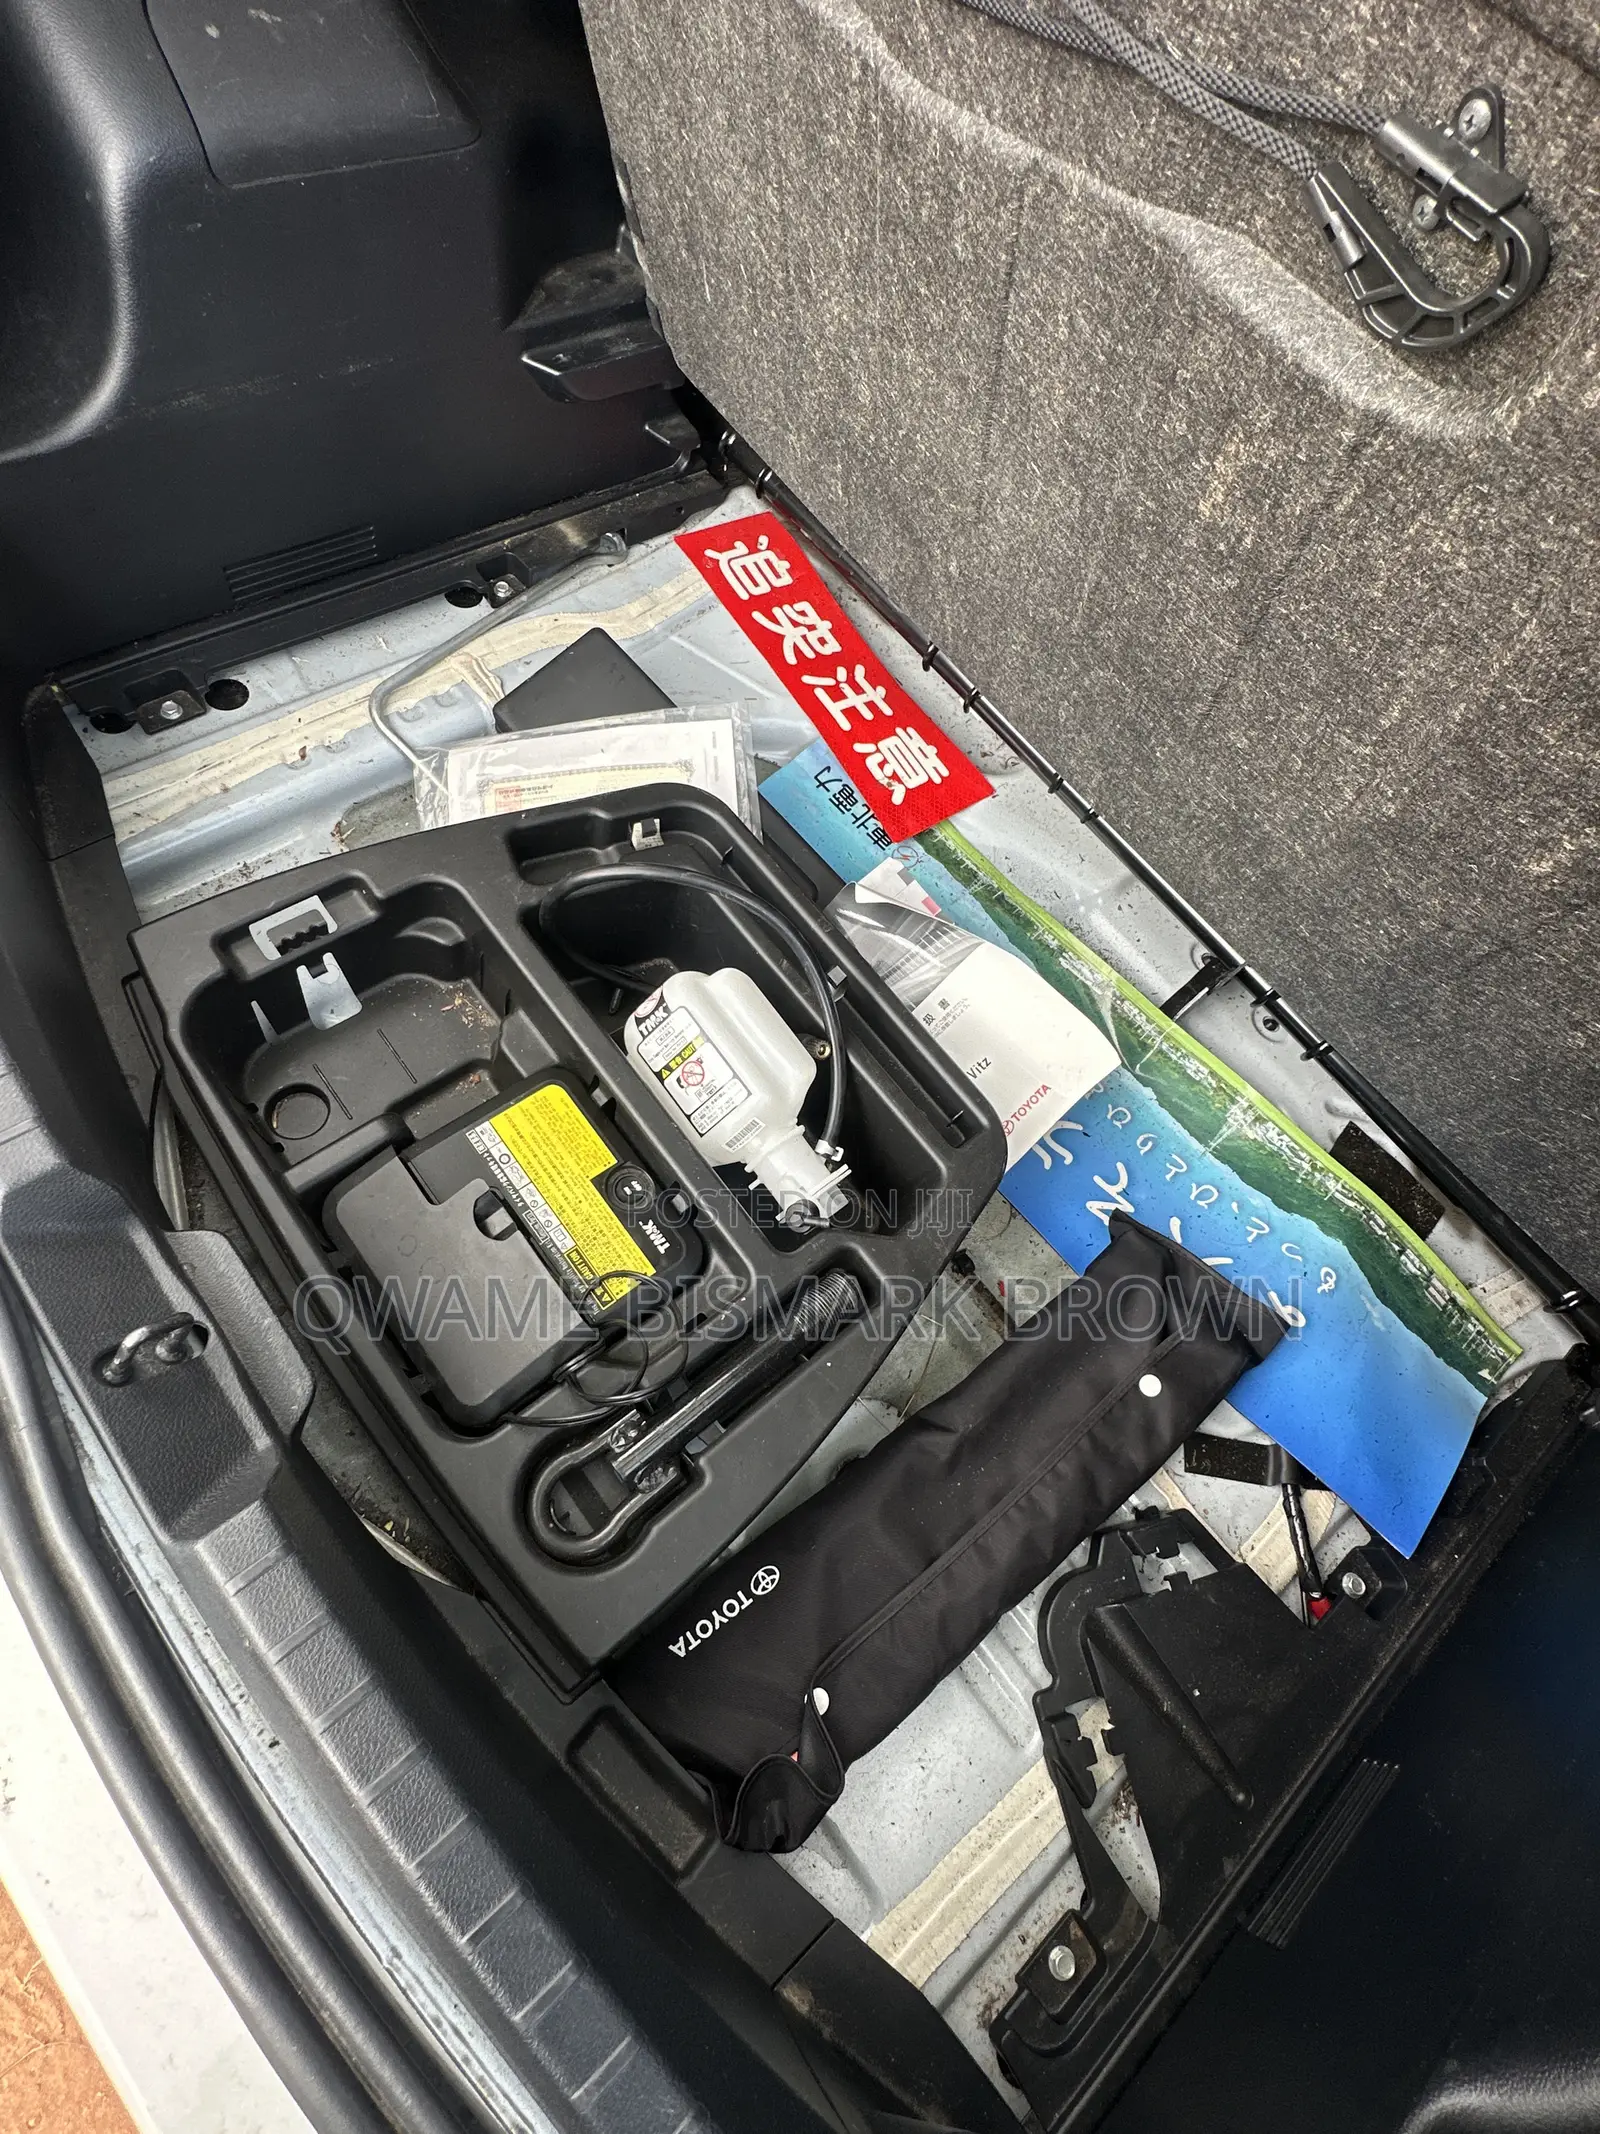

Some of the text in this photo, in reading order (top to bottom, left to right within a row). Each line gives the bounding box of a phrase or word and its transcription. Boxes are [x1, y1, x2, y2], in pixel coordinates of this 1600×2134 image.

[704, 534, 950, 806] 追突注意
[814, 765, 893, 850] 東北電力
[966, 1056, 992, 1080] Vitz
[1011, 1084, 1052, 1123] TOYOTA
[568, 1249, 595, 1281] CAUTION
[668, 1590, 754, 1658] TOYOTA
